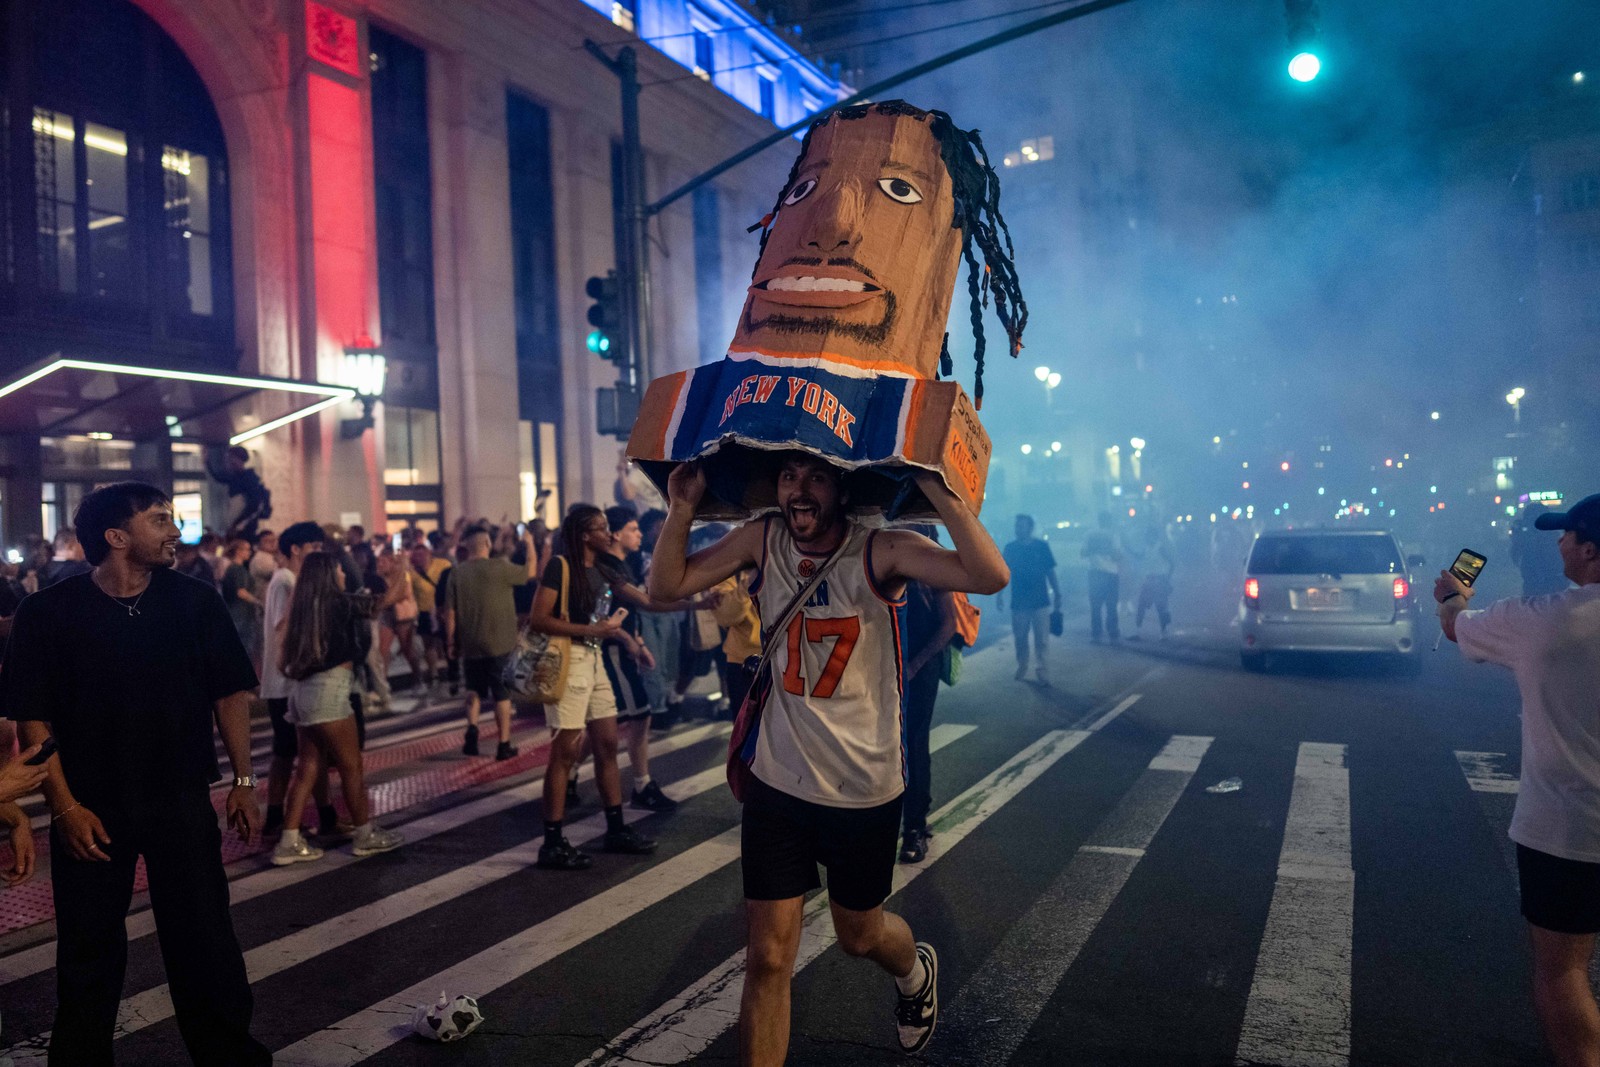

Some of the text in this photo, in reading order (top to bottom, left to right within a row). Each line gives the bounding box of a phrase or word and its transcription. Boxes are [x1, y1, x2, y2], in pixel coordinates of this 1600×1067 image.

[718, 375, 856, 449] NEW YORK
[950, 434, 978, 493] KNICKS
[965, 432, 978, 462] the
[783, 611, 861, 698] 17
